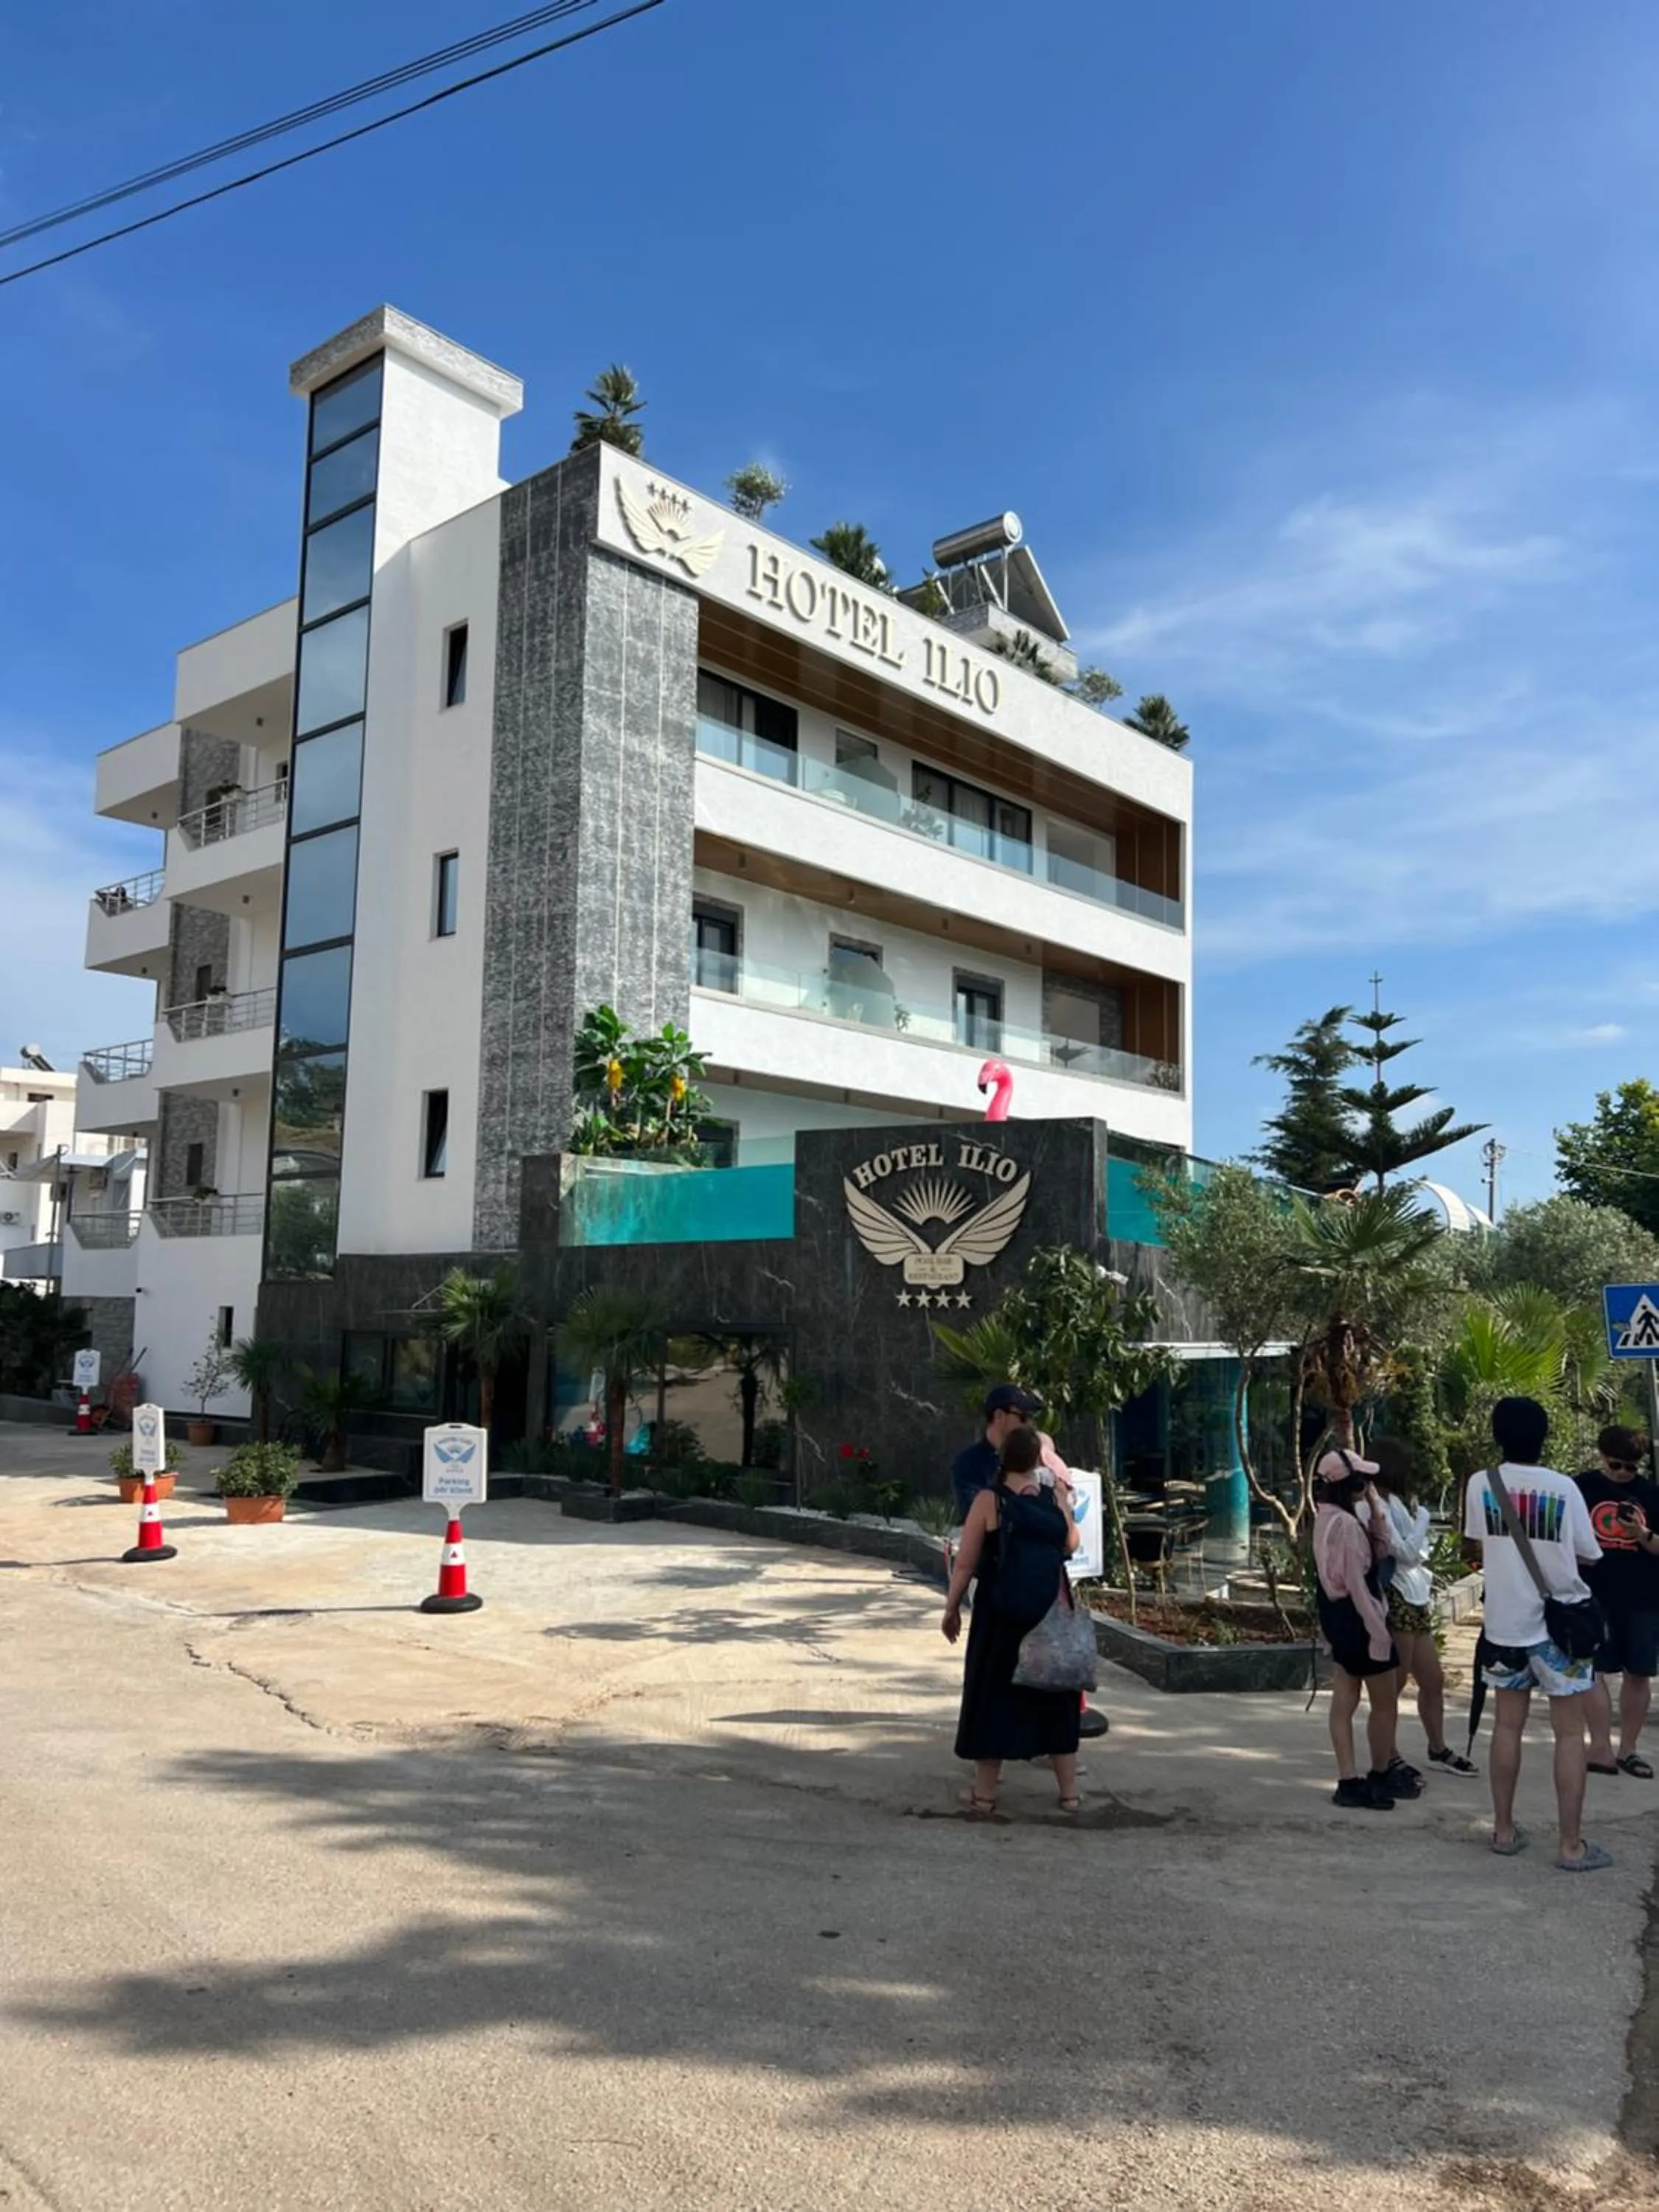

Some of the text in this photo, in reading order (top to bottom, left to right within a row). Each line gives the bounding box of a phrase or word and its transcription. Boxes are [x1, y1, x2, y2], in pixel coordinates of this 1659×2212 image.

[747, 544, 1001, 714] HOTEL ILIO
[852, 1144, 1018, 1189] HOTEL ILIO
